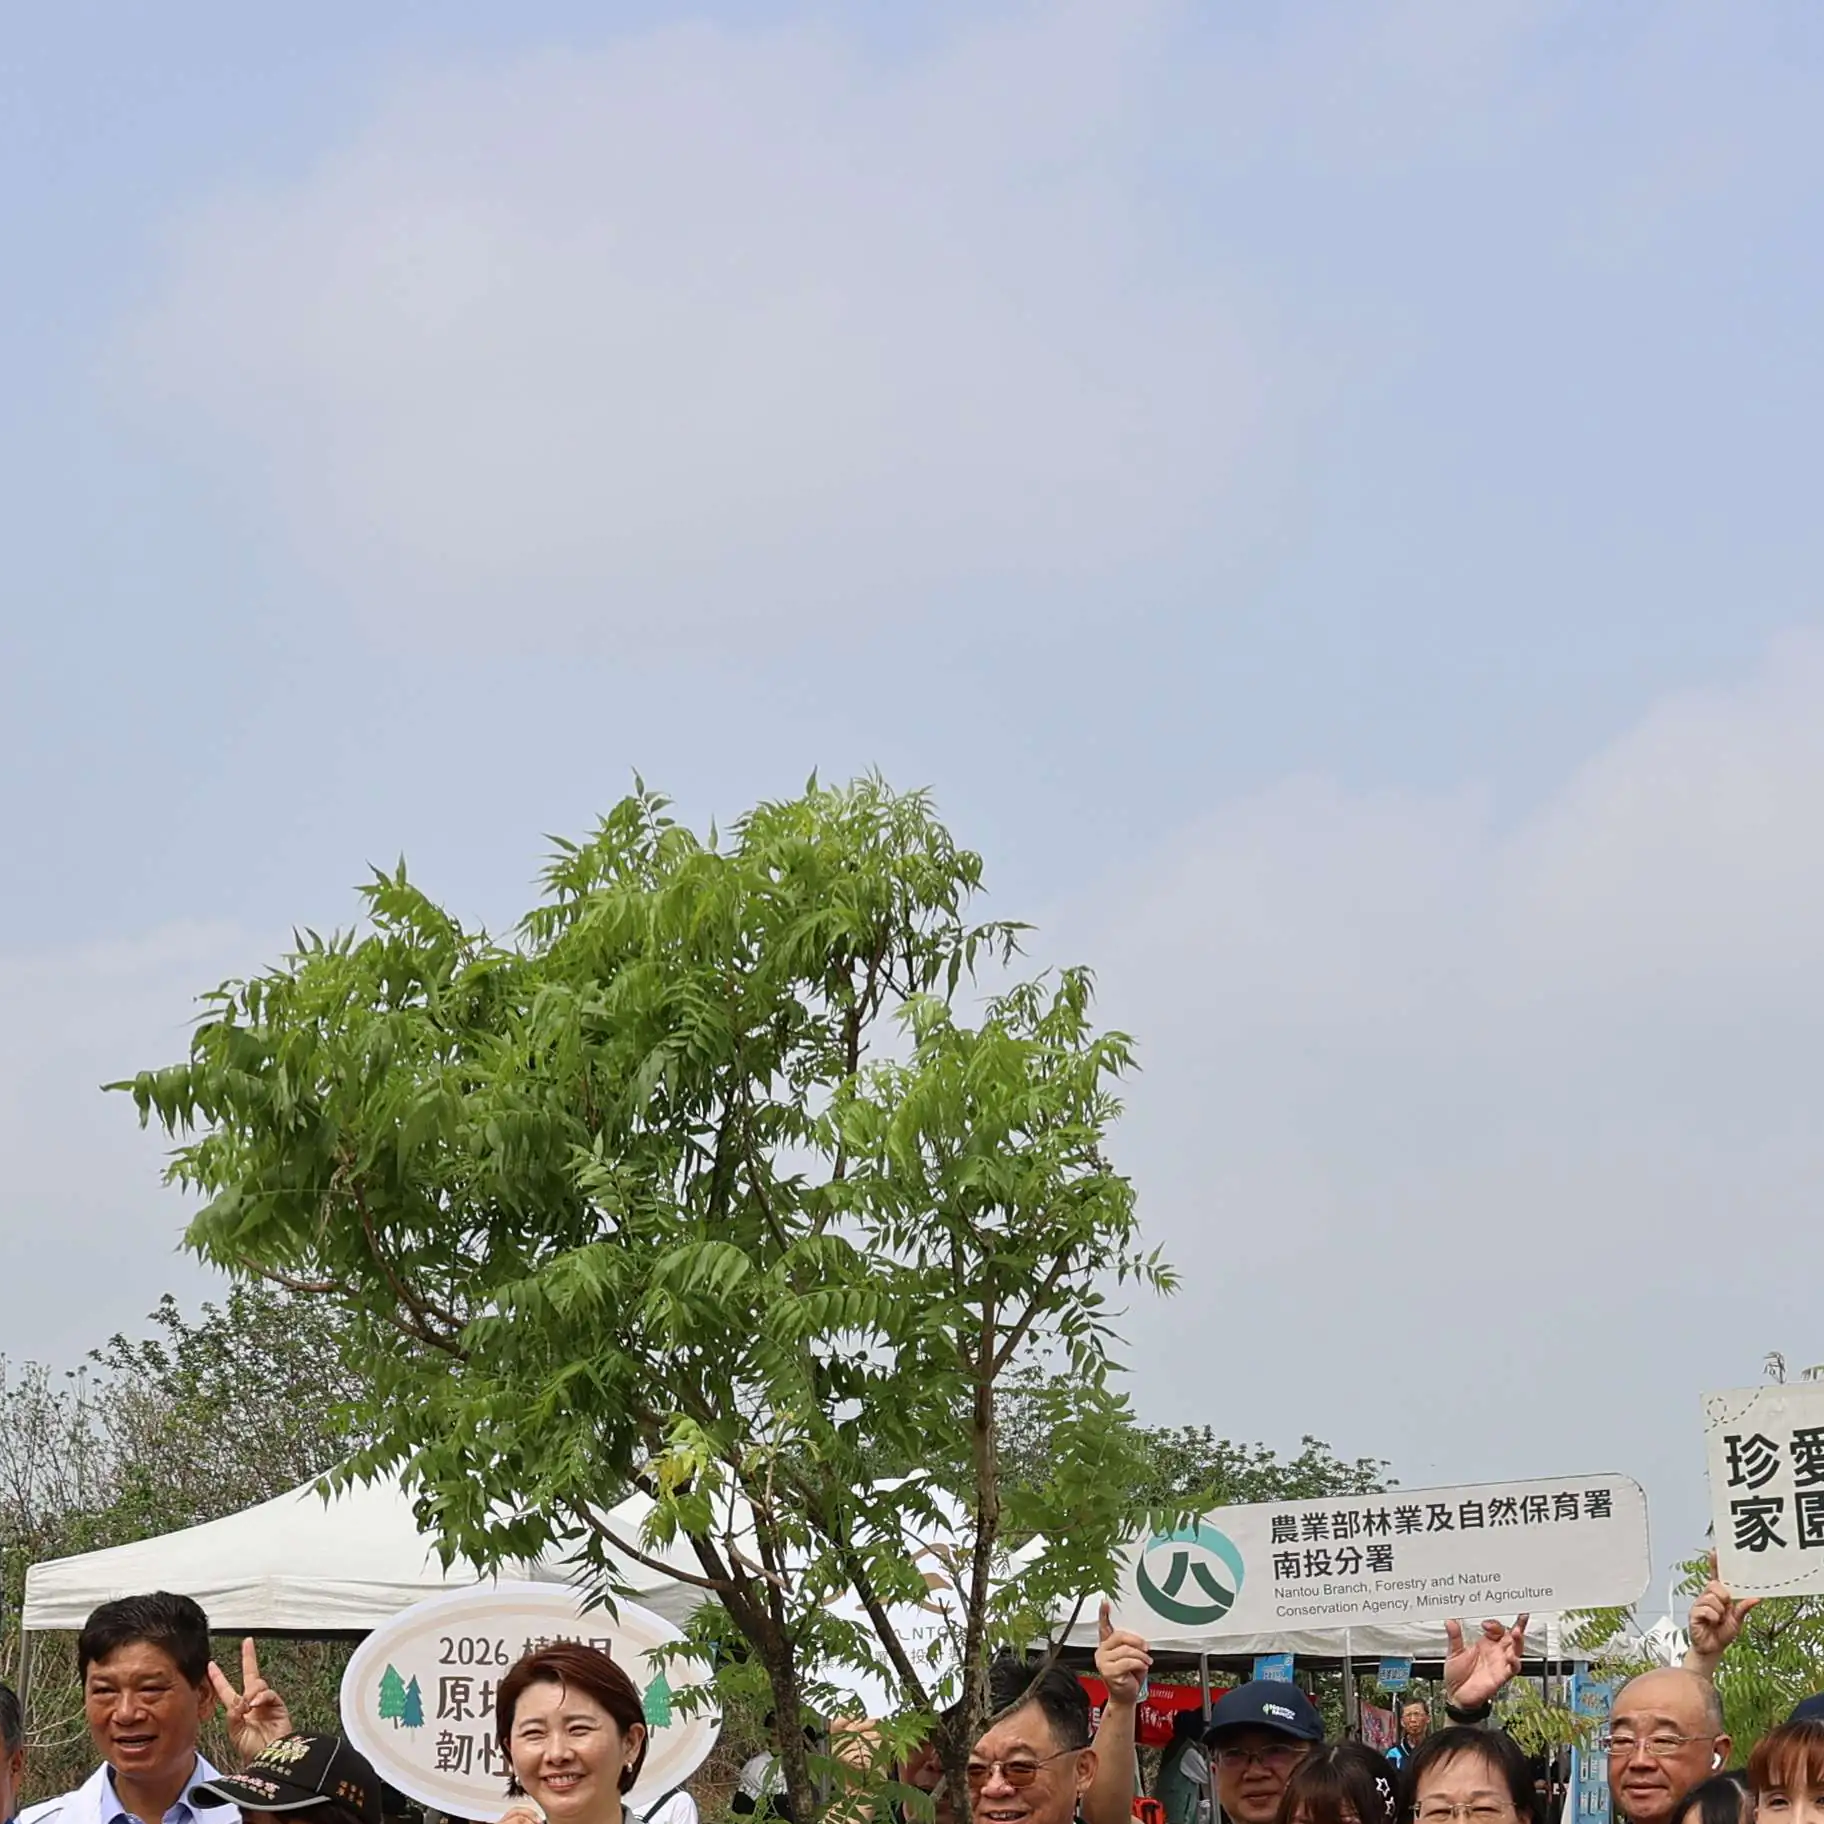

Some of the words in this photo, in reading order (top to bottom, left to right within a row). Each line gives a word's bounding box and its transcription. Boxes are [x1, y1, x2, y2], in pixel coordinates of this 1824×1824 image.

[1270, 1489, 1613, 1546] 農業部林業及自然保育署
[1272, 1542, 1395, 1581] 南投分署
[1275, 1583, 1319, 1599] Nantou
[1324, 1581, 1372, 1596] Branch,
[1375, 1576, 1426, 1592] Forestry
[1431, 1575, 1454, 1588] and
[1458, 1571, 1501, 1585] Nature
[1276, 1599, 1358, 1618] Conservation
[1362, 1598, 1412, 1614] Agency,
[1417, 1591, 1465, 1608] Ministry
[1469, 1591, 1482, 1603] of
[1485, 1585, 1553, 1603] Agriculture
[438, 1636, 510, 1666] 2026
